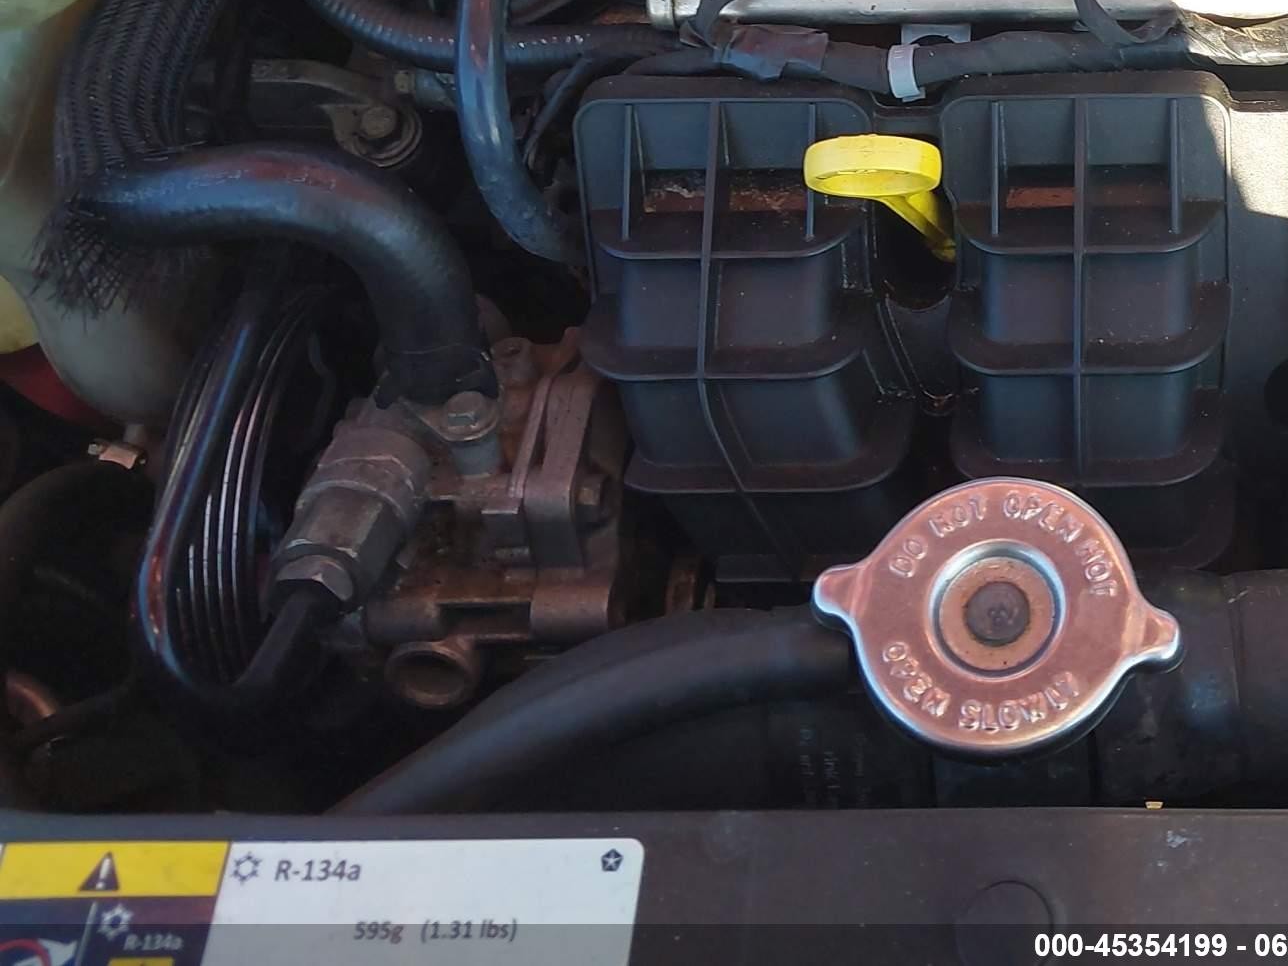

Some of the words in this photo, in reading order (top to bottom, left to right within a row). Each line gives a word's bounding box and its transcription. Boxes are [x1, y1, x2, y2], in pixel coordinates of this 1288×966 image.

[889, 536, 929, 578] DO
[928, 497, 989, 538] NOT
[1001, 489, 1085, 544] OPEN
[1074, 539, 1118, 597] HOT
[881, 641, 952, 718] OPEN
[957, 671, 1080, 733] SLOWLY
[274, 859, 362, 882] R-134a
[124, 934, 184, 951] R-134a
[353, 920, 404, 945] 595g
[420, 919, 473, 944] (1.31
[479, 918, 519, 944] lbs)
